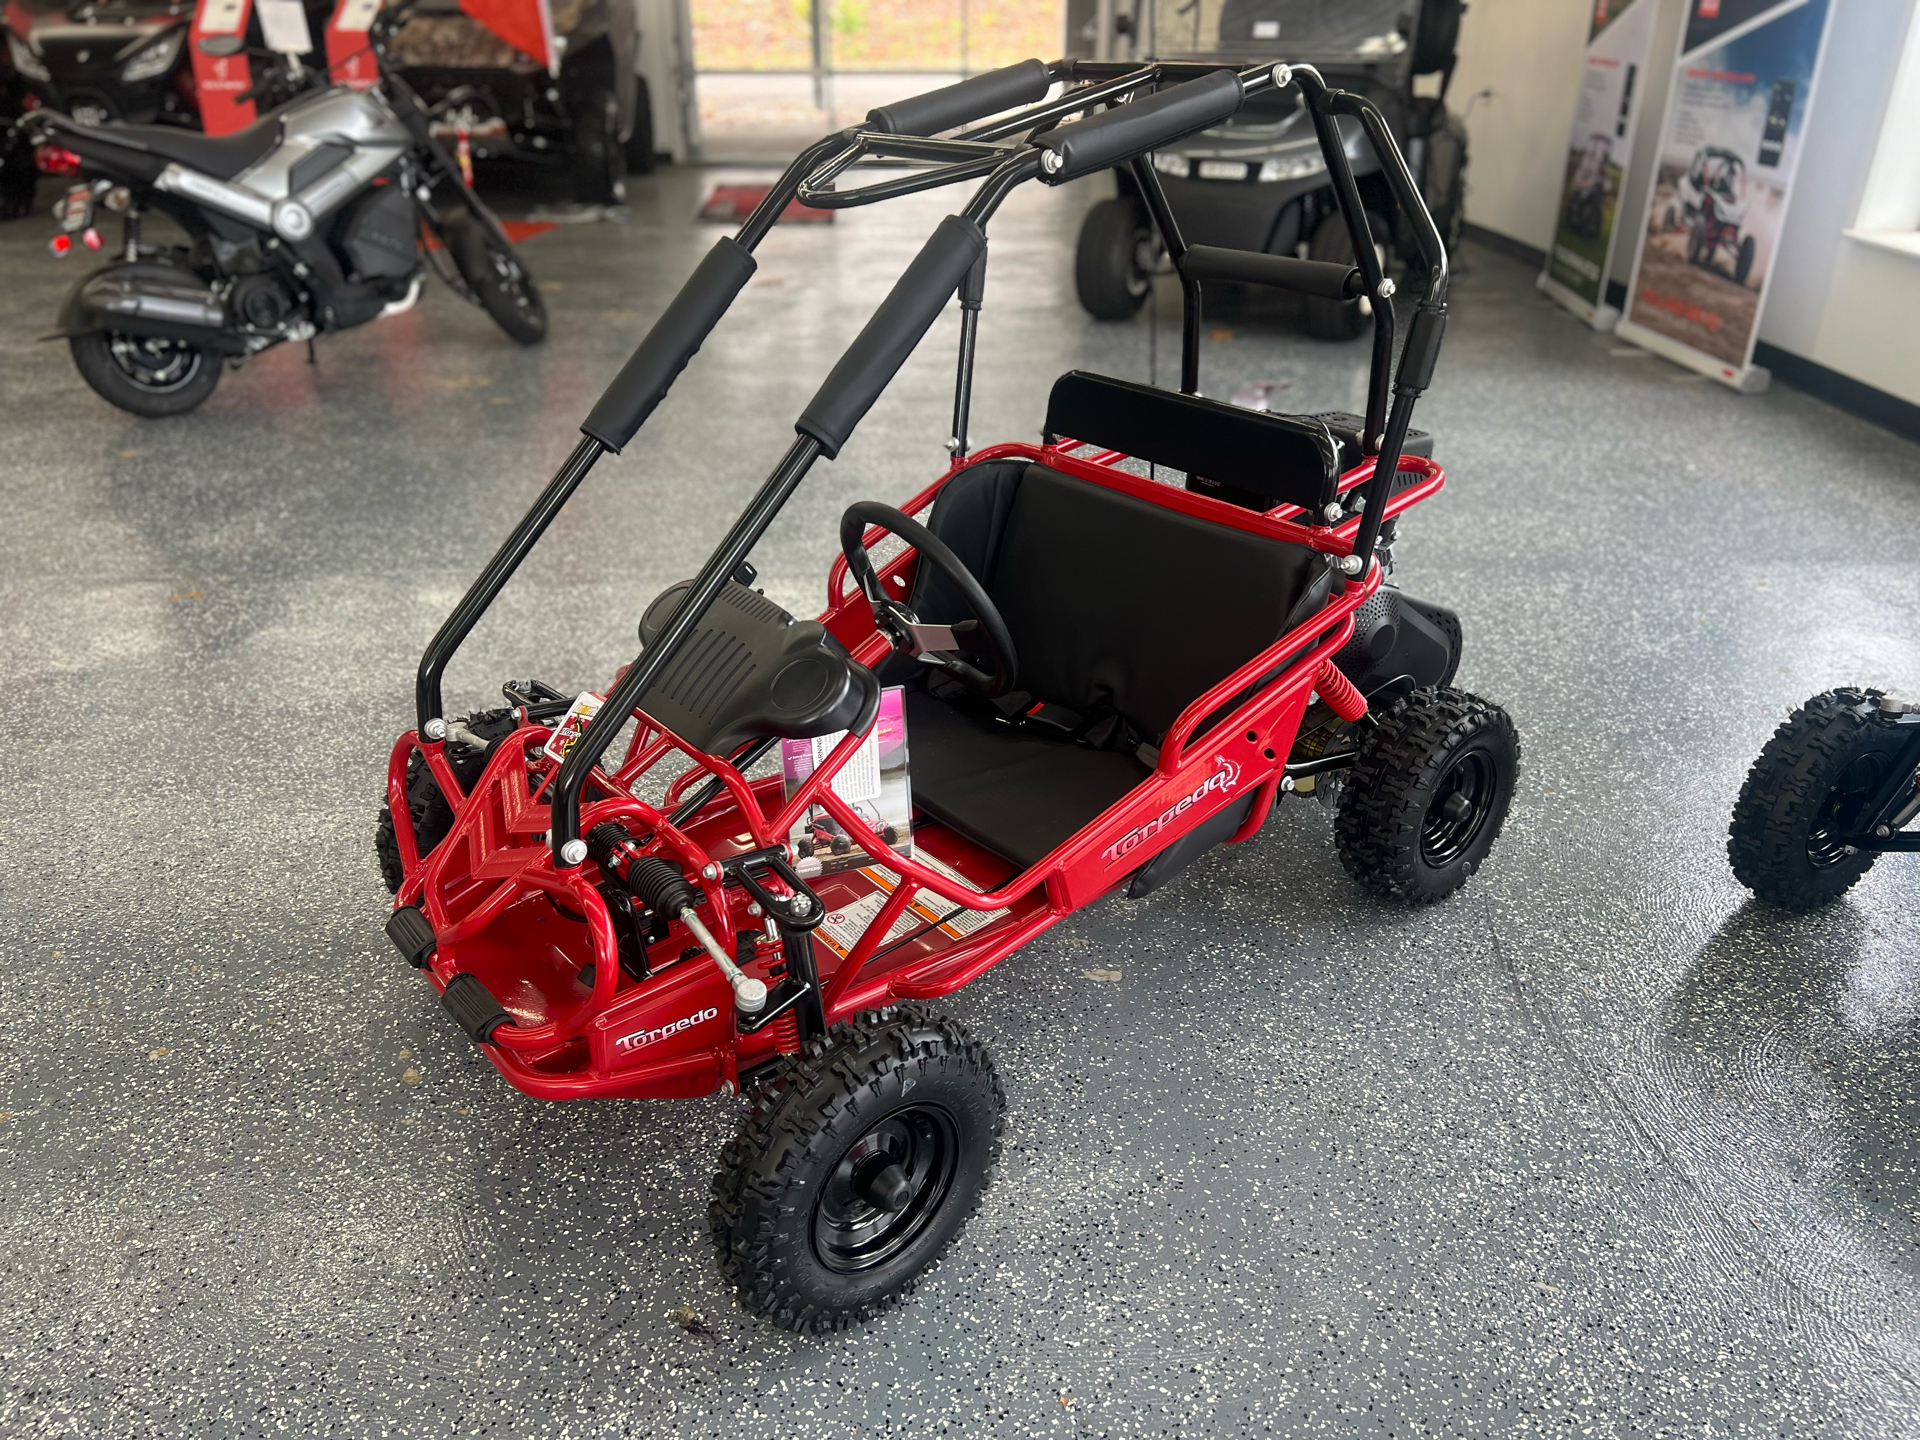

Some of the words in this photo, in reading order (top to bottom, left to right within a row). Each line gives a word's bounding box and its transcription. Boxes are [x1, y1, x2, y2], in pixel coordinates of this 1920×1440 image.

[1101, 769, 1229, 861] Torpedo
[813, 927, 837, 948] WARNING
[615, 1006, 718, 1051] Torpedo
